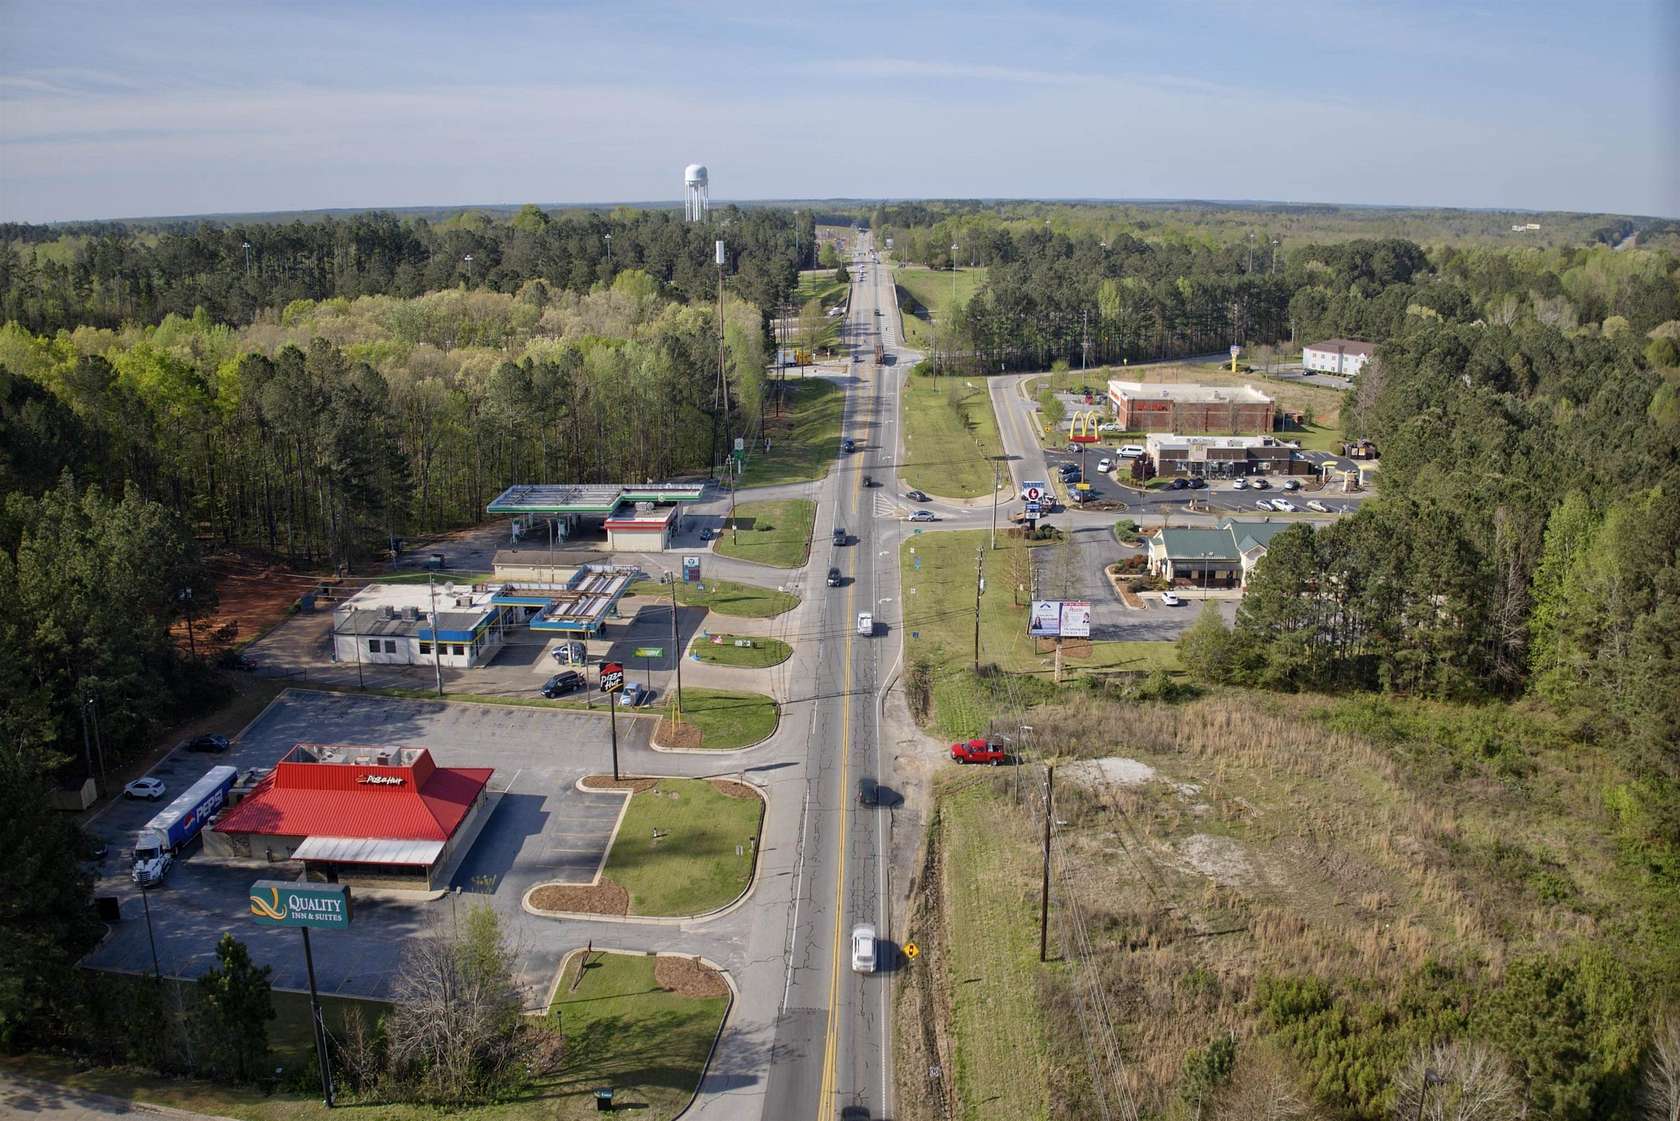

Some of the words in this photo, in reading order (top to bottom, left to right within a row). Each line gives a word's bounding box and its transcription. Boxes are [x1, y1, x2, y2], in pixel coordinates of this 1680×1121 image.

[604, 679, 621, 690] Hut
[196, 789, 223, 823] PEPSI
[289, 894, 341, 912] QUALITY
[292, 912, 307, 920] INN
[308, 912, 314, 920] &
[315, 913, 343, 921] SUITES
